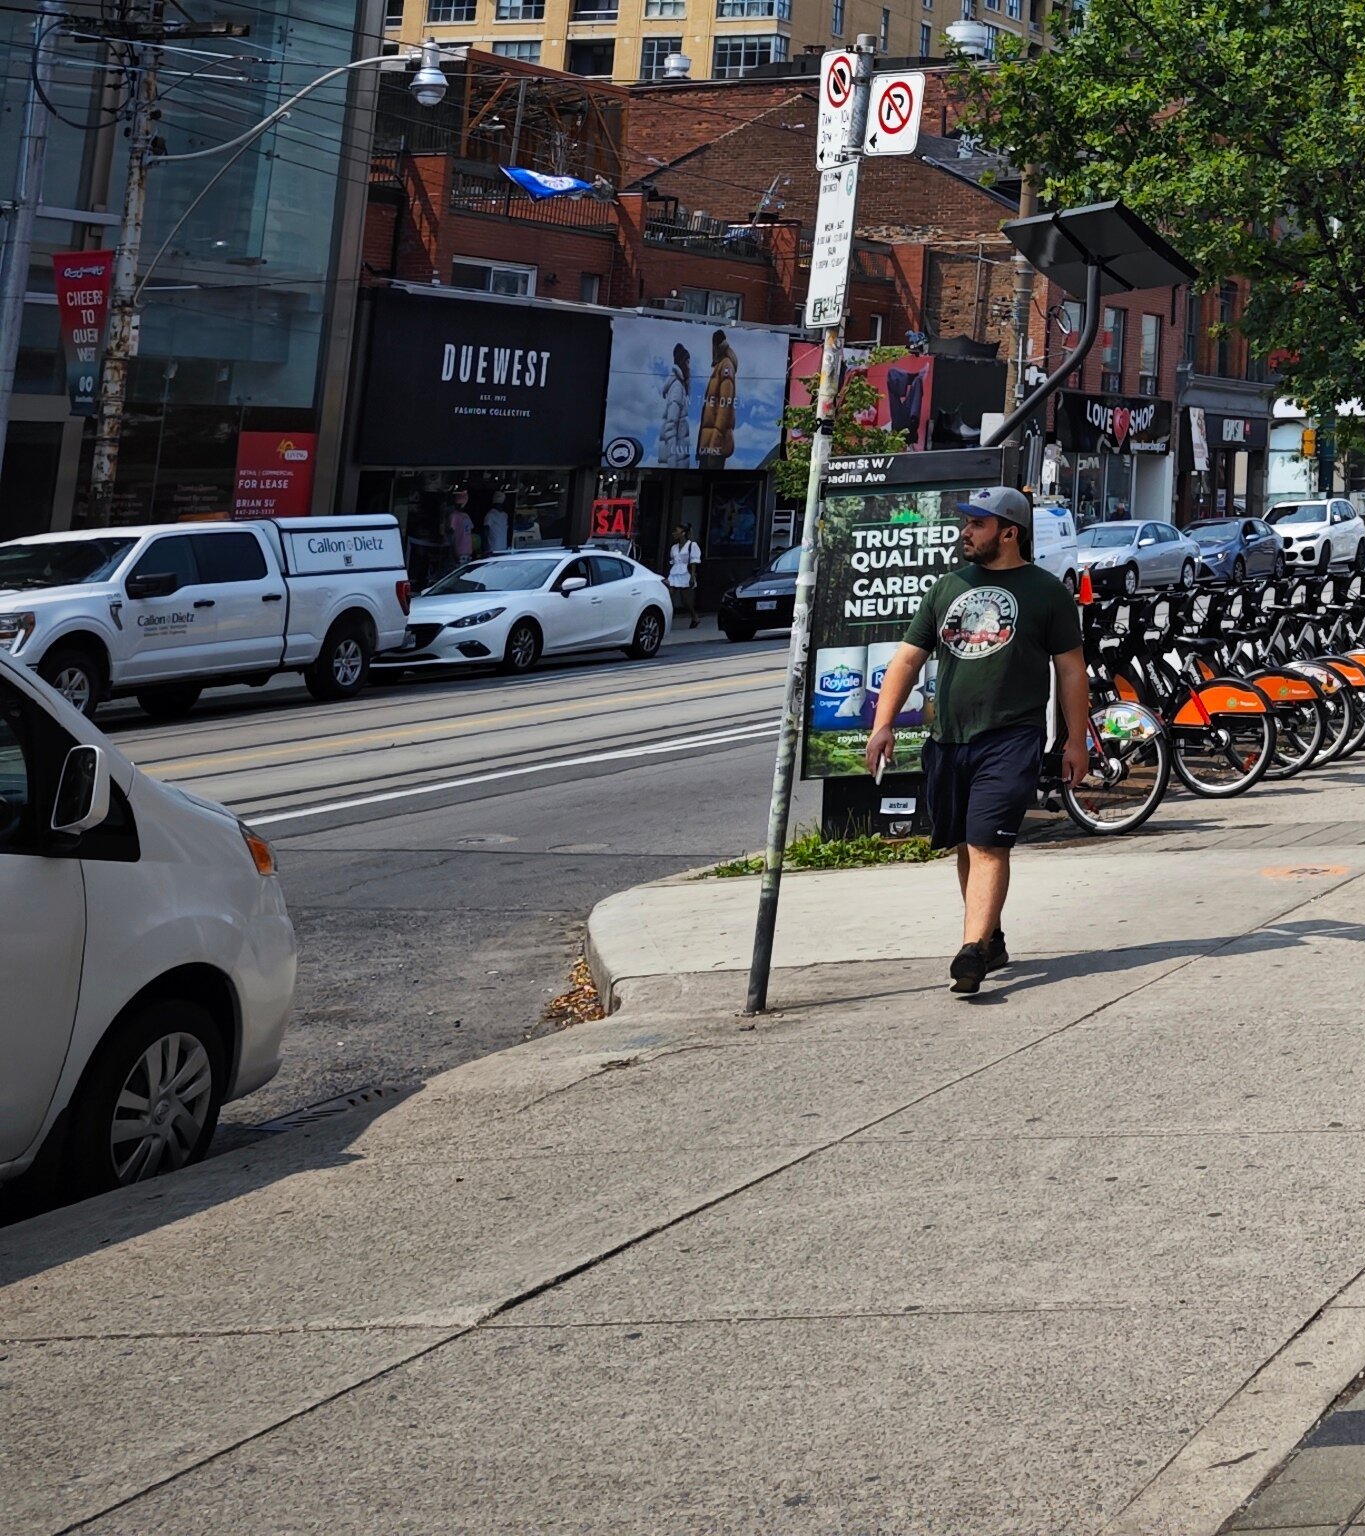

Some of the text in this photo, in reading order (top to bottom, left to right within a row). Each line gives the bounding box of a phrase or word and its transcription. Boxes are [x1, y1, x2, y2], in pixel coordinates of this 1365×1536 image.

[81, 309, 95, 325] TO
[441, 343, 551, 388] DUEWEST
[454, 406, 531, 417] FASHION COLLECTIVE
[1086, 399, 1156, 437] LOVE SHOP
[857, 458, 869, 469] St
[871, 458, 885, 469] W
[238, 479, 289, 489] FOR LEASE
[828, 472, 886, 484] adina Ave
[236, 498, 262, 508] BRIAN
[851, 524, 961, 549] TRUSTED
[307, 535, 385, 555] Callon Dietz
[850, 545, 959, 574] QUALITY.
[852, 573, 944, 597] CARBO
[844, 595, 923, 618] NEUTR
[822, 675, 860, 691] Royale
[888, 800, 909, 810] astral
